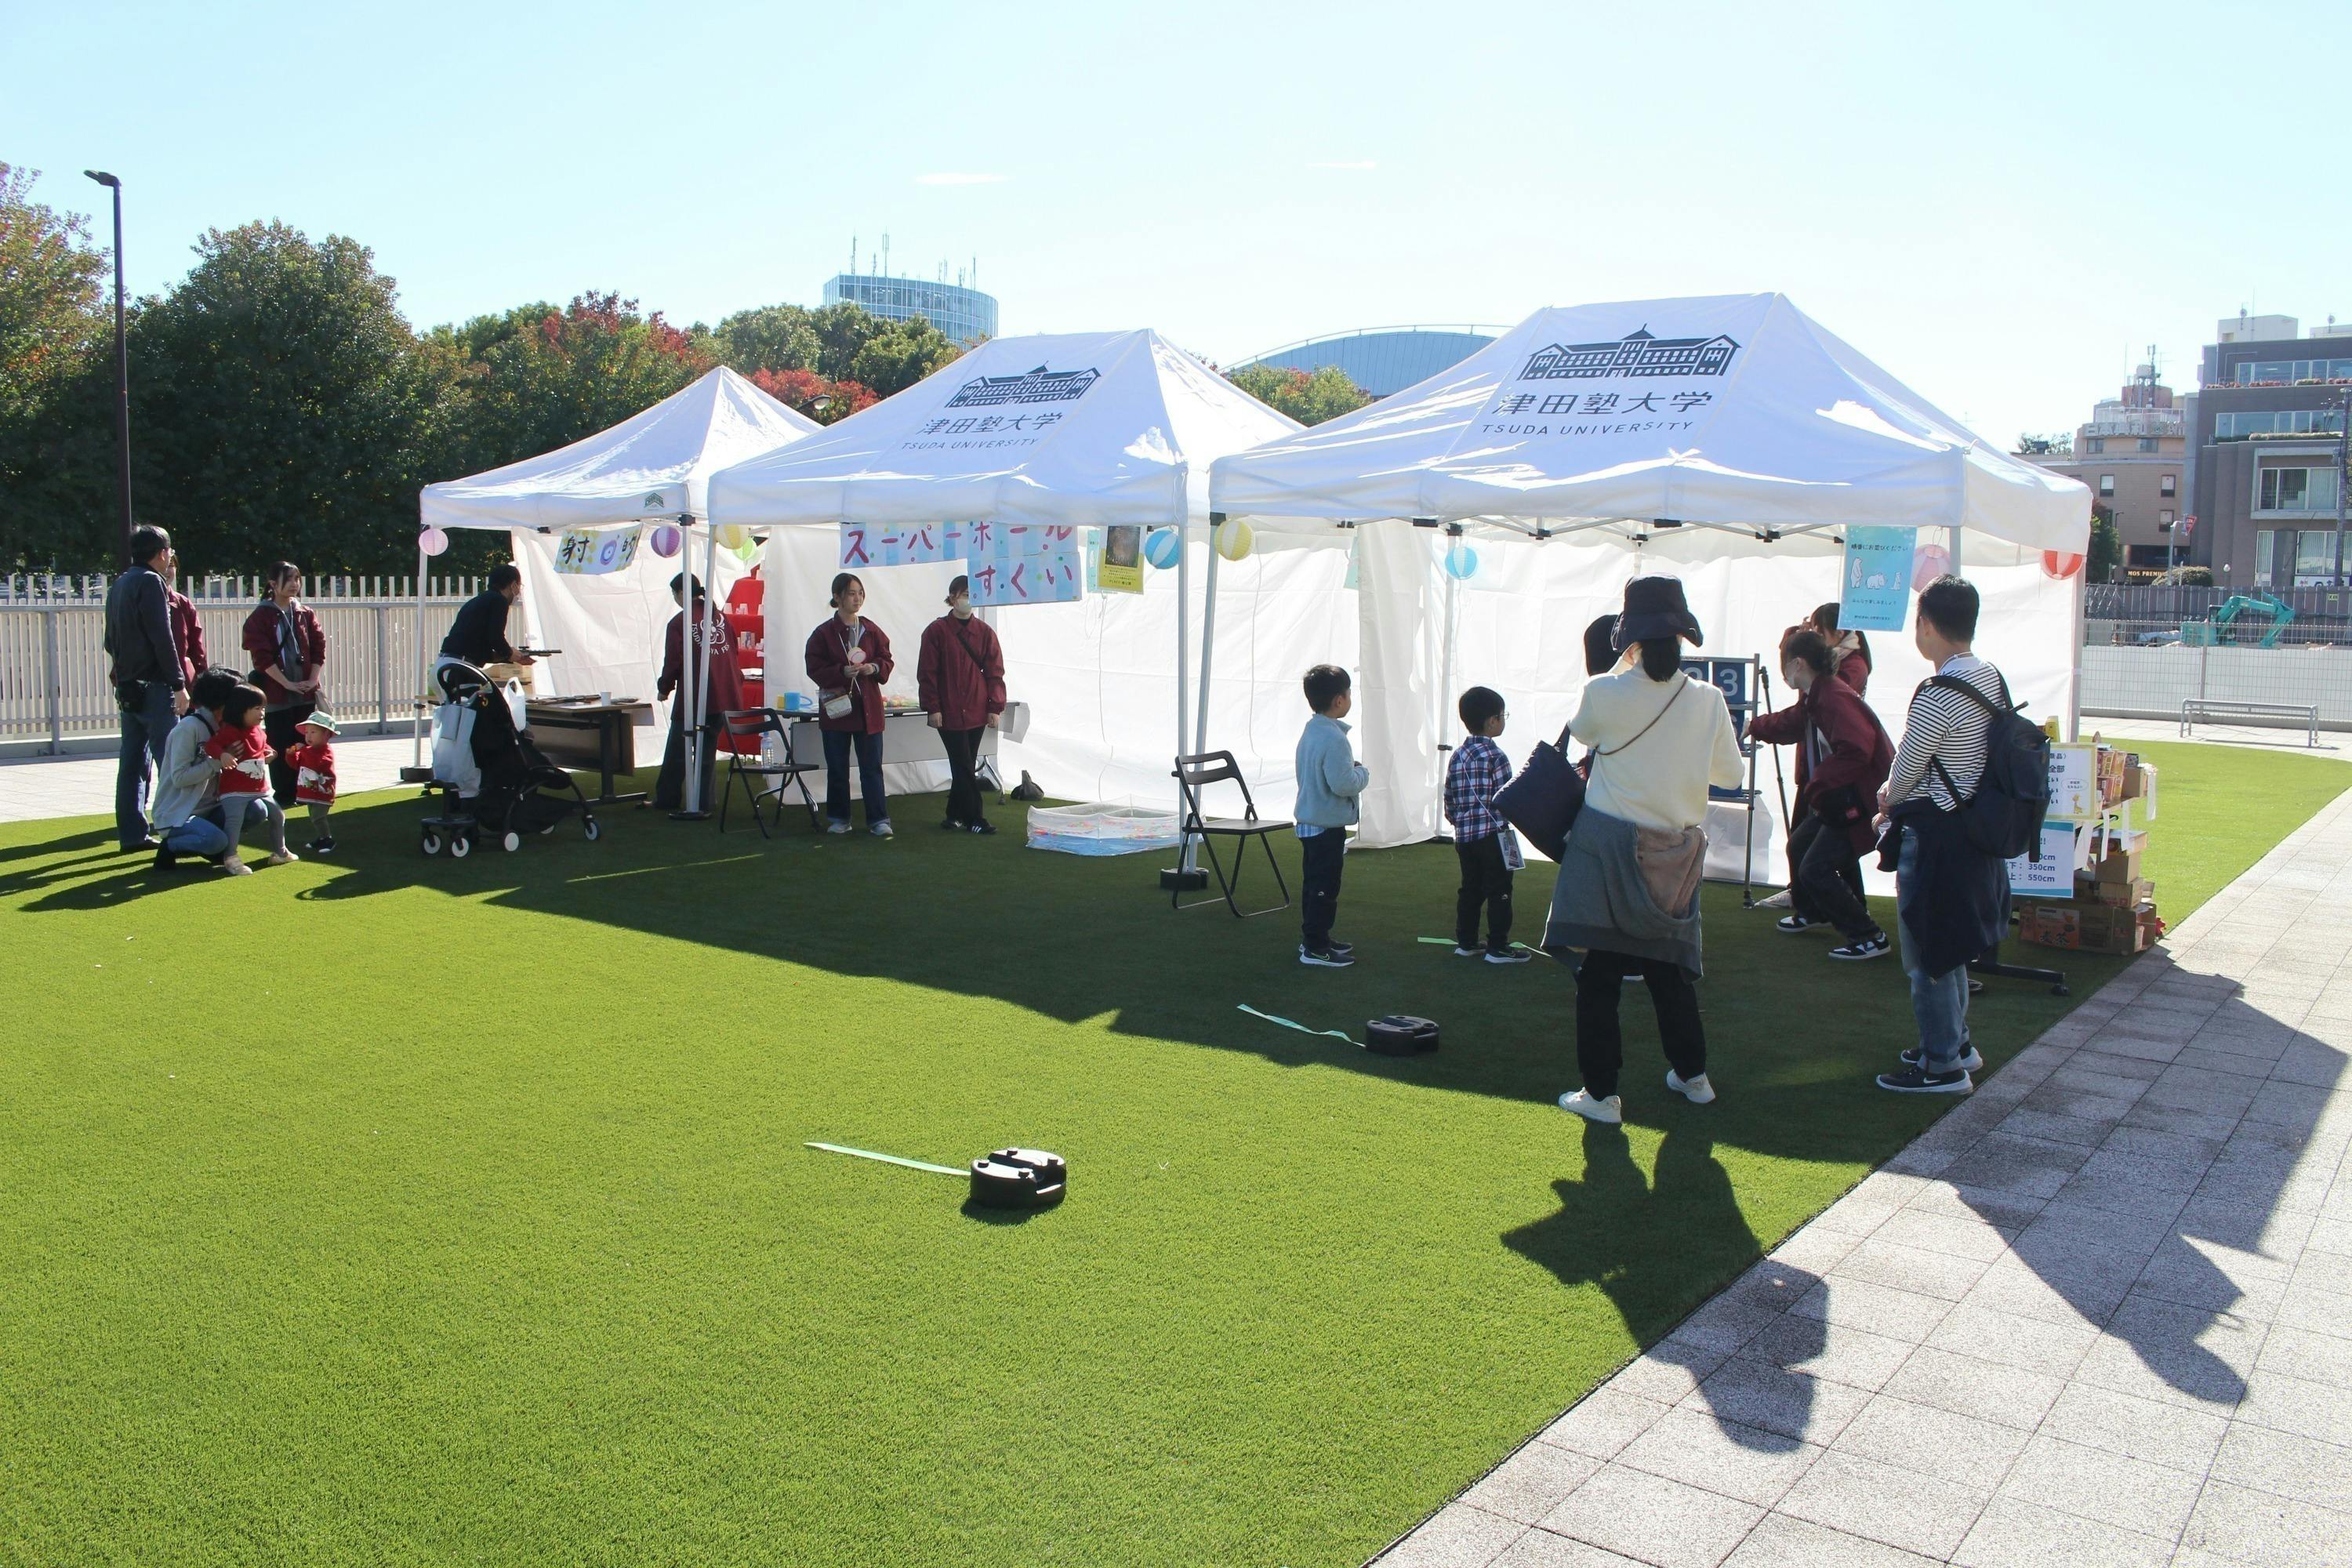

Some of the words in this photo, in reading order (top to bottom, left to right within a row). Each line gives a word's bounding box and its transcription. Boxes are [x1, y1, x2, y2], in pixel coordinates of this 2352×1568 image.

[1491, 391, 1712, 416] 津田塾大学
[915, 412, 1063, 435] 津田塾大学
[1482, 424, 1549, 435] TSUDA
[1560, 421, 1693, 435] UNIVERSITY
[902, 441, 945, 450] TSUDA
[951, 438, 1040, 450] UNIVERSITY
[975, 563, 1073, 597] すくい
[1719, 669, 1738, 696] 3
